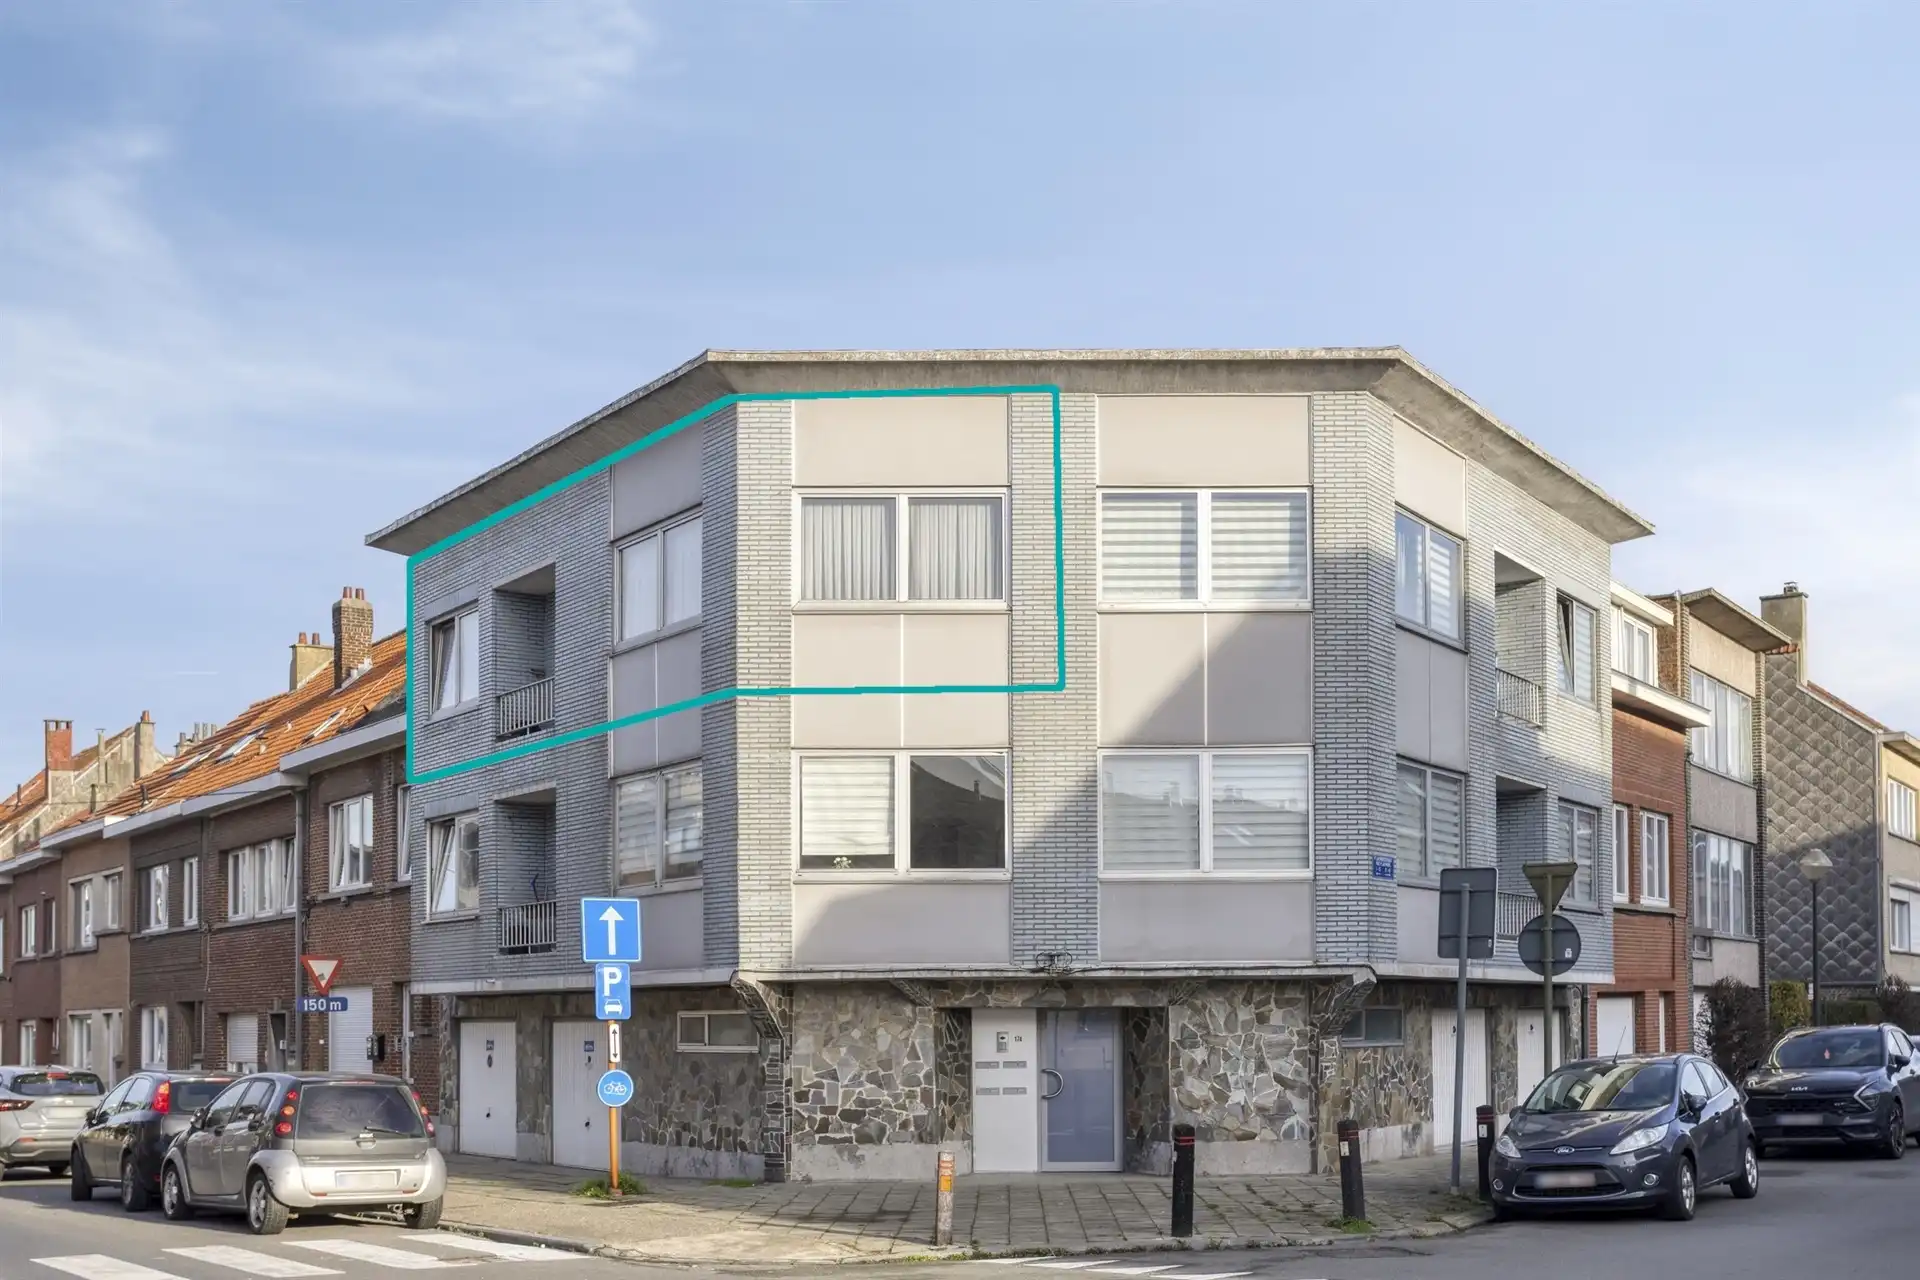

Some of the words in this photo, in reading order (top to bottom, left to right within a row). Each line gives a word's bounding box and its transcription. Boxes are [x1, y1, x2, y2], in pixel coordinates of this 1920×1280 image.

[603, 966, 622, 997] P
[303, 998, 327, 1011] 150
[330, 1001, 342, 1011] m
